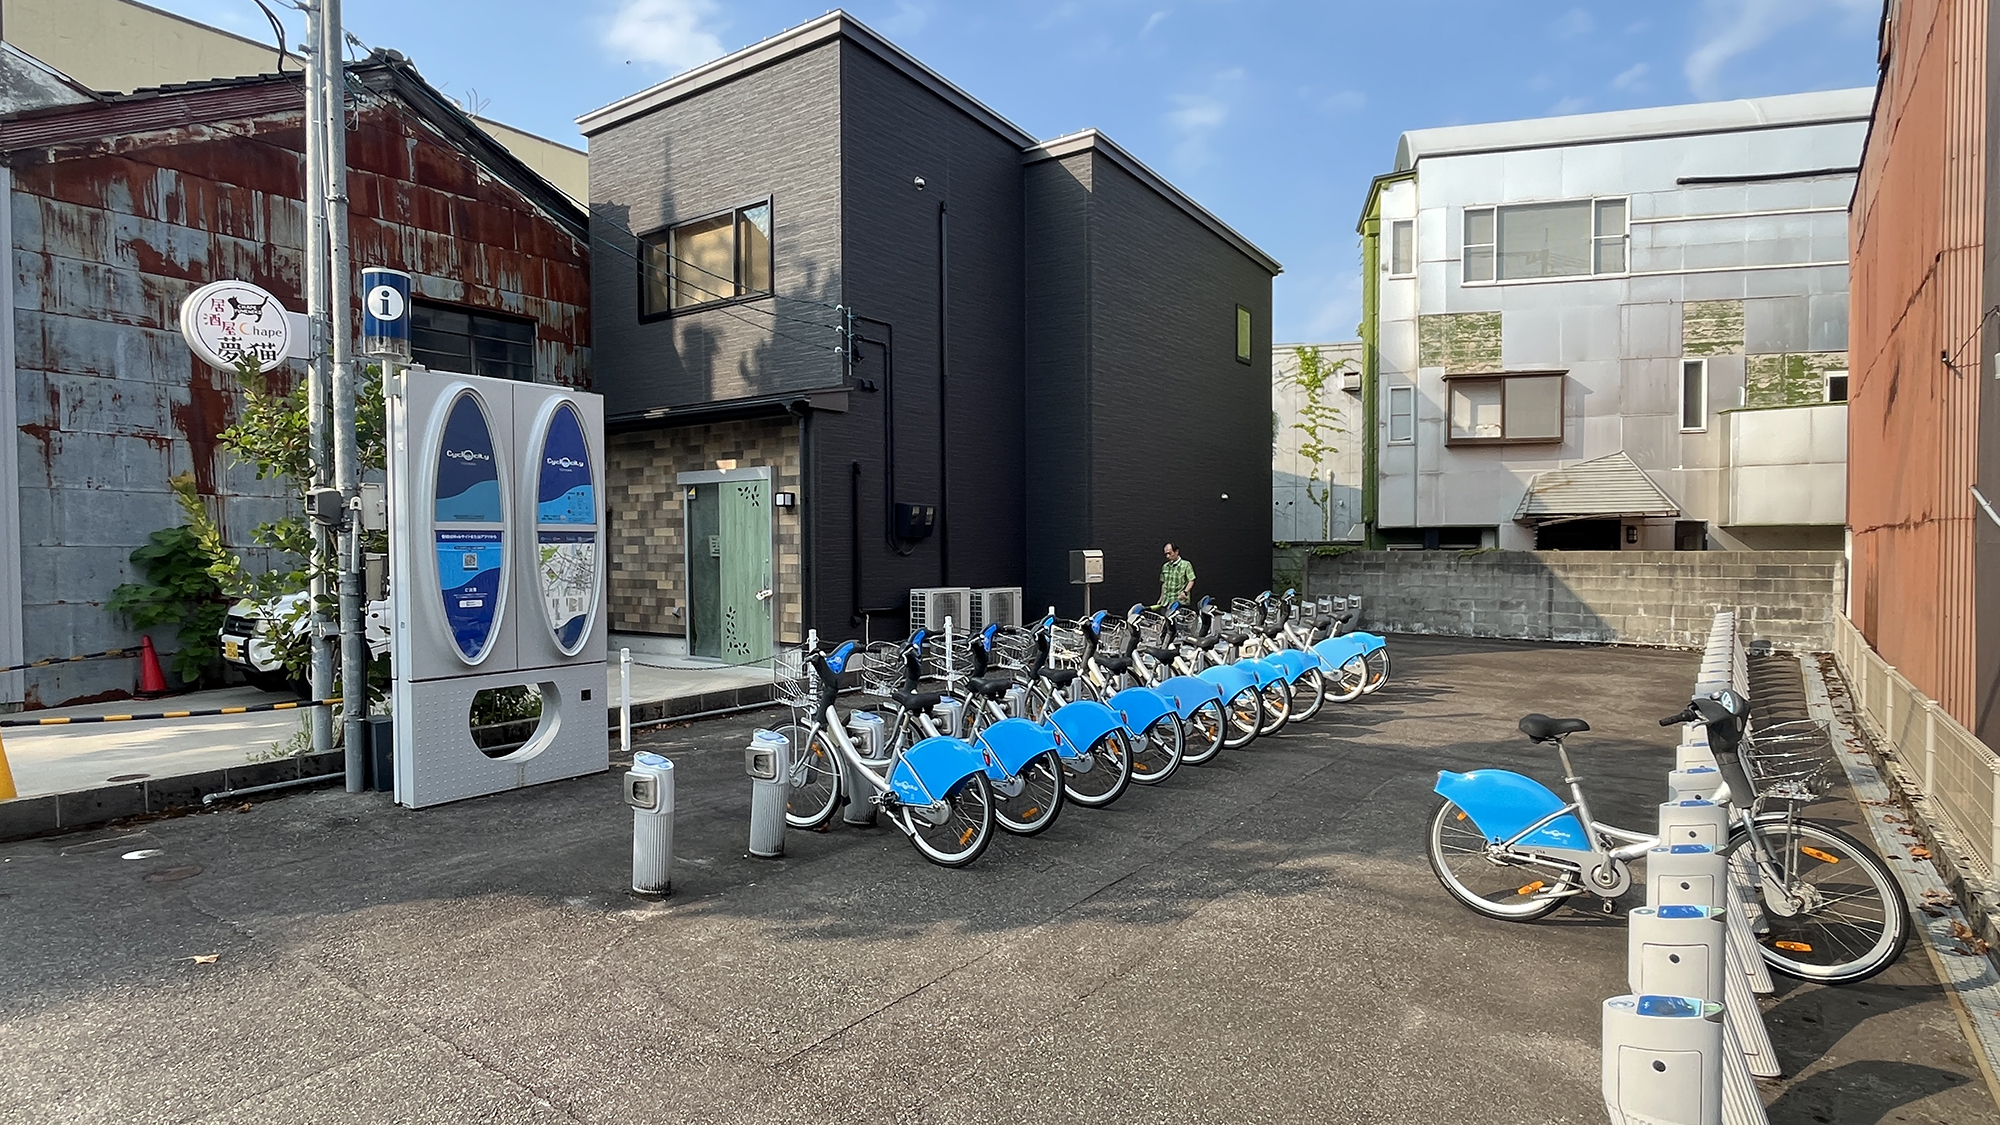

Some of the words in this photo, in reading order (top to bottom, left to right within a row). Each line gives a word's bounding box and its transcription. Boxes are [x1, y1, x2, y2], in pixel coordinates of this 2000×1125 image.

[203, 298, 236, 336] 居酒屋
[239, 322, 282, 339] Chape
[217, 336, 276, 363] 夢猫
